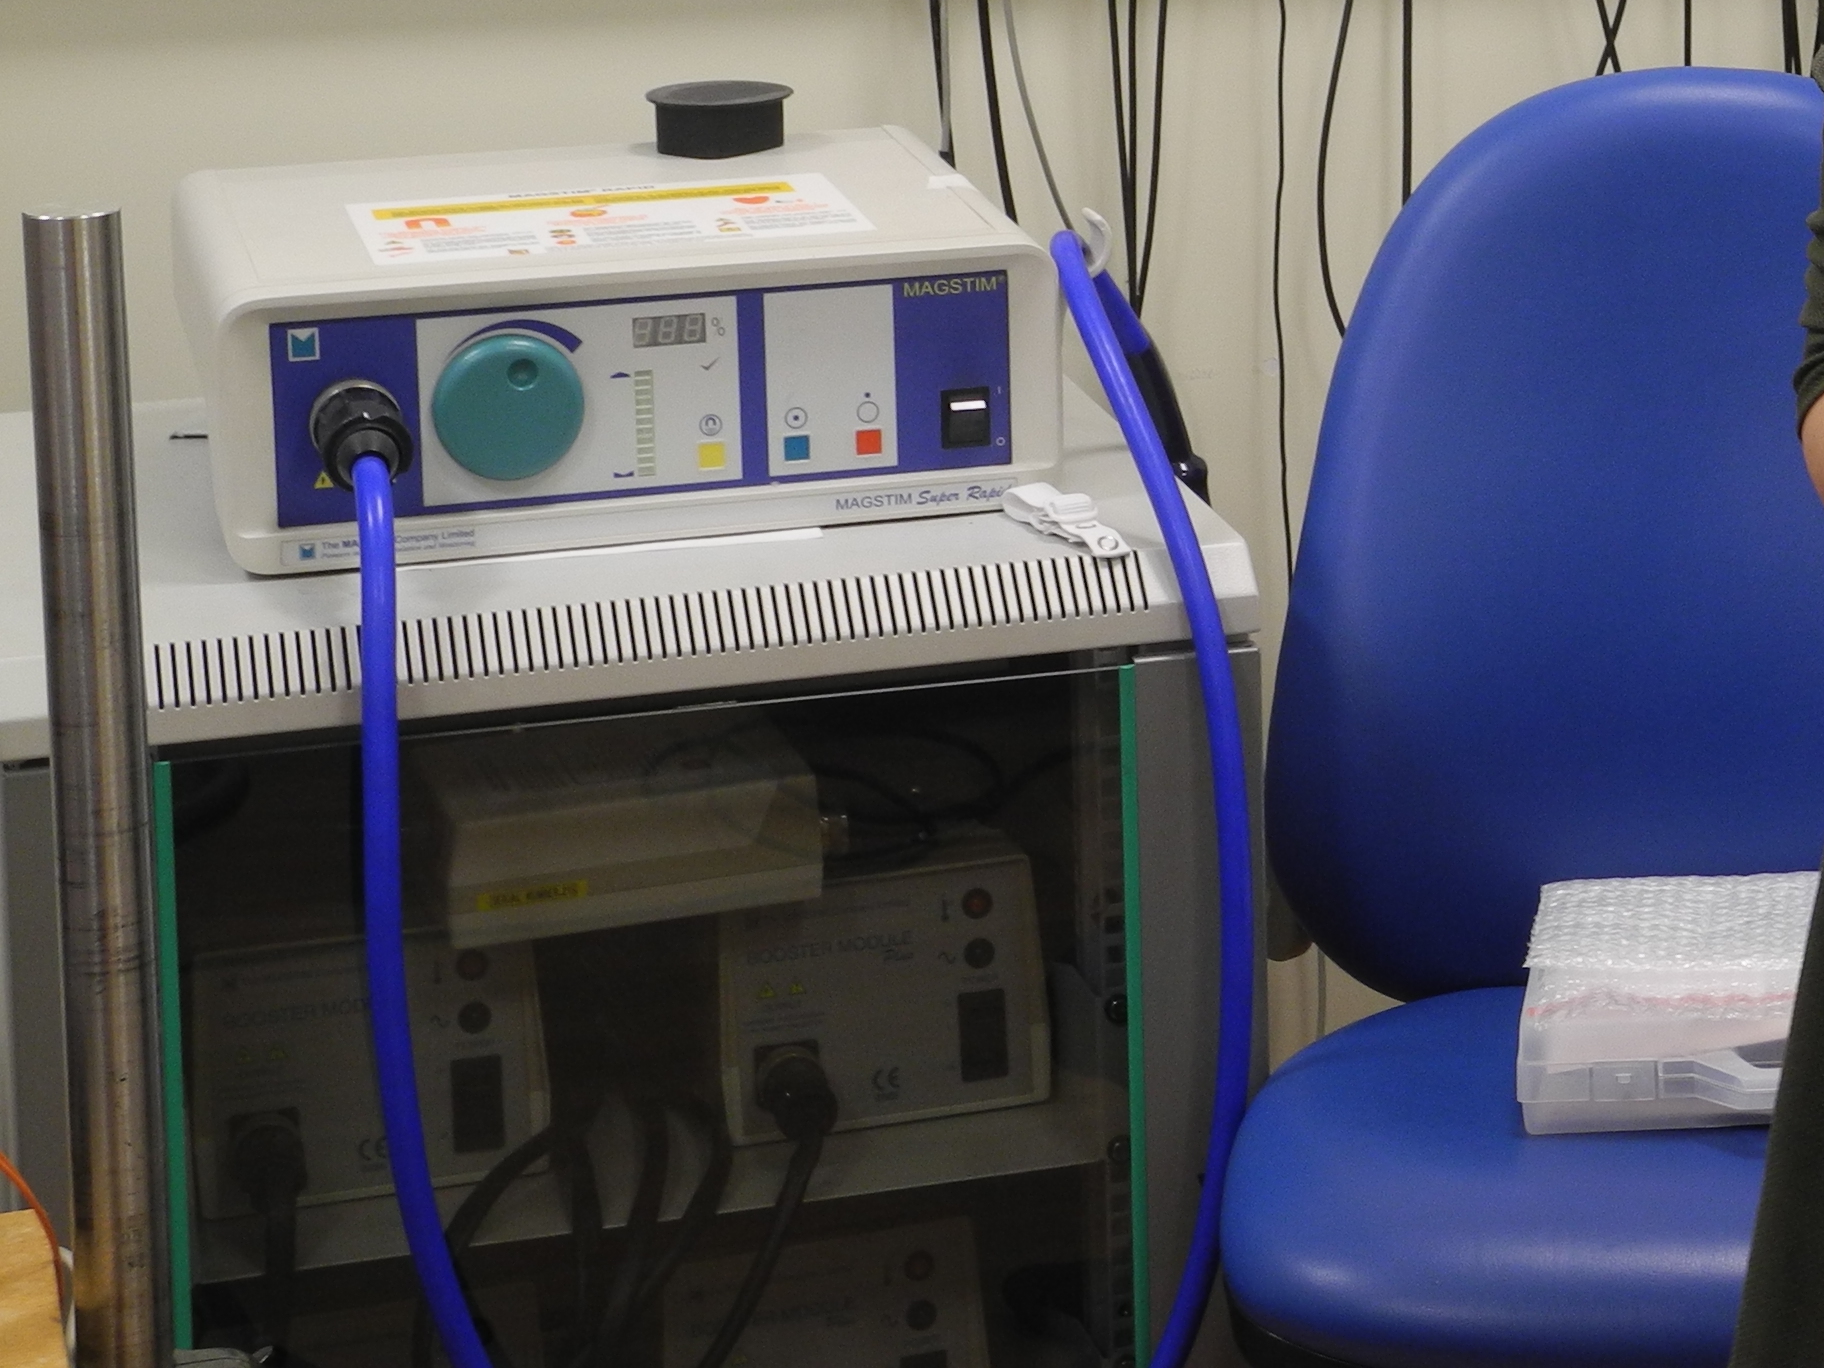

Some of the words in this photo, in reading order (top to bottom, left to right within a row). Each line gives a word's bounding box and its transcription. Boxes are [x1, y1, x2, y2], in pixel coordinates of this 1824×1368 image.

[903, 276, 997, 298] MAGSTIM
[835, 492, 912, 511] MAGSTIM
[916, 489, 960, 506] Super
